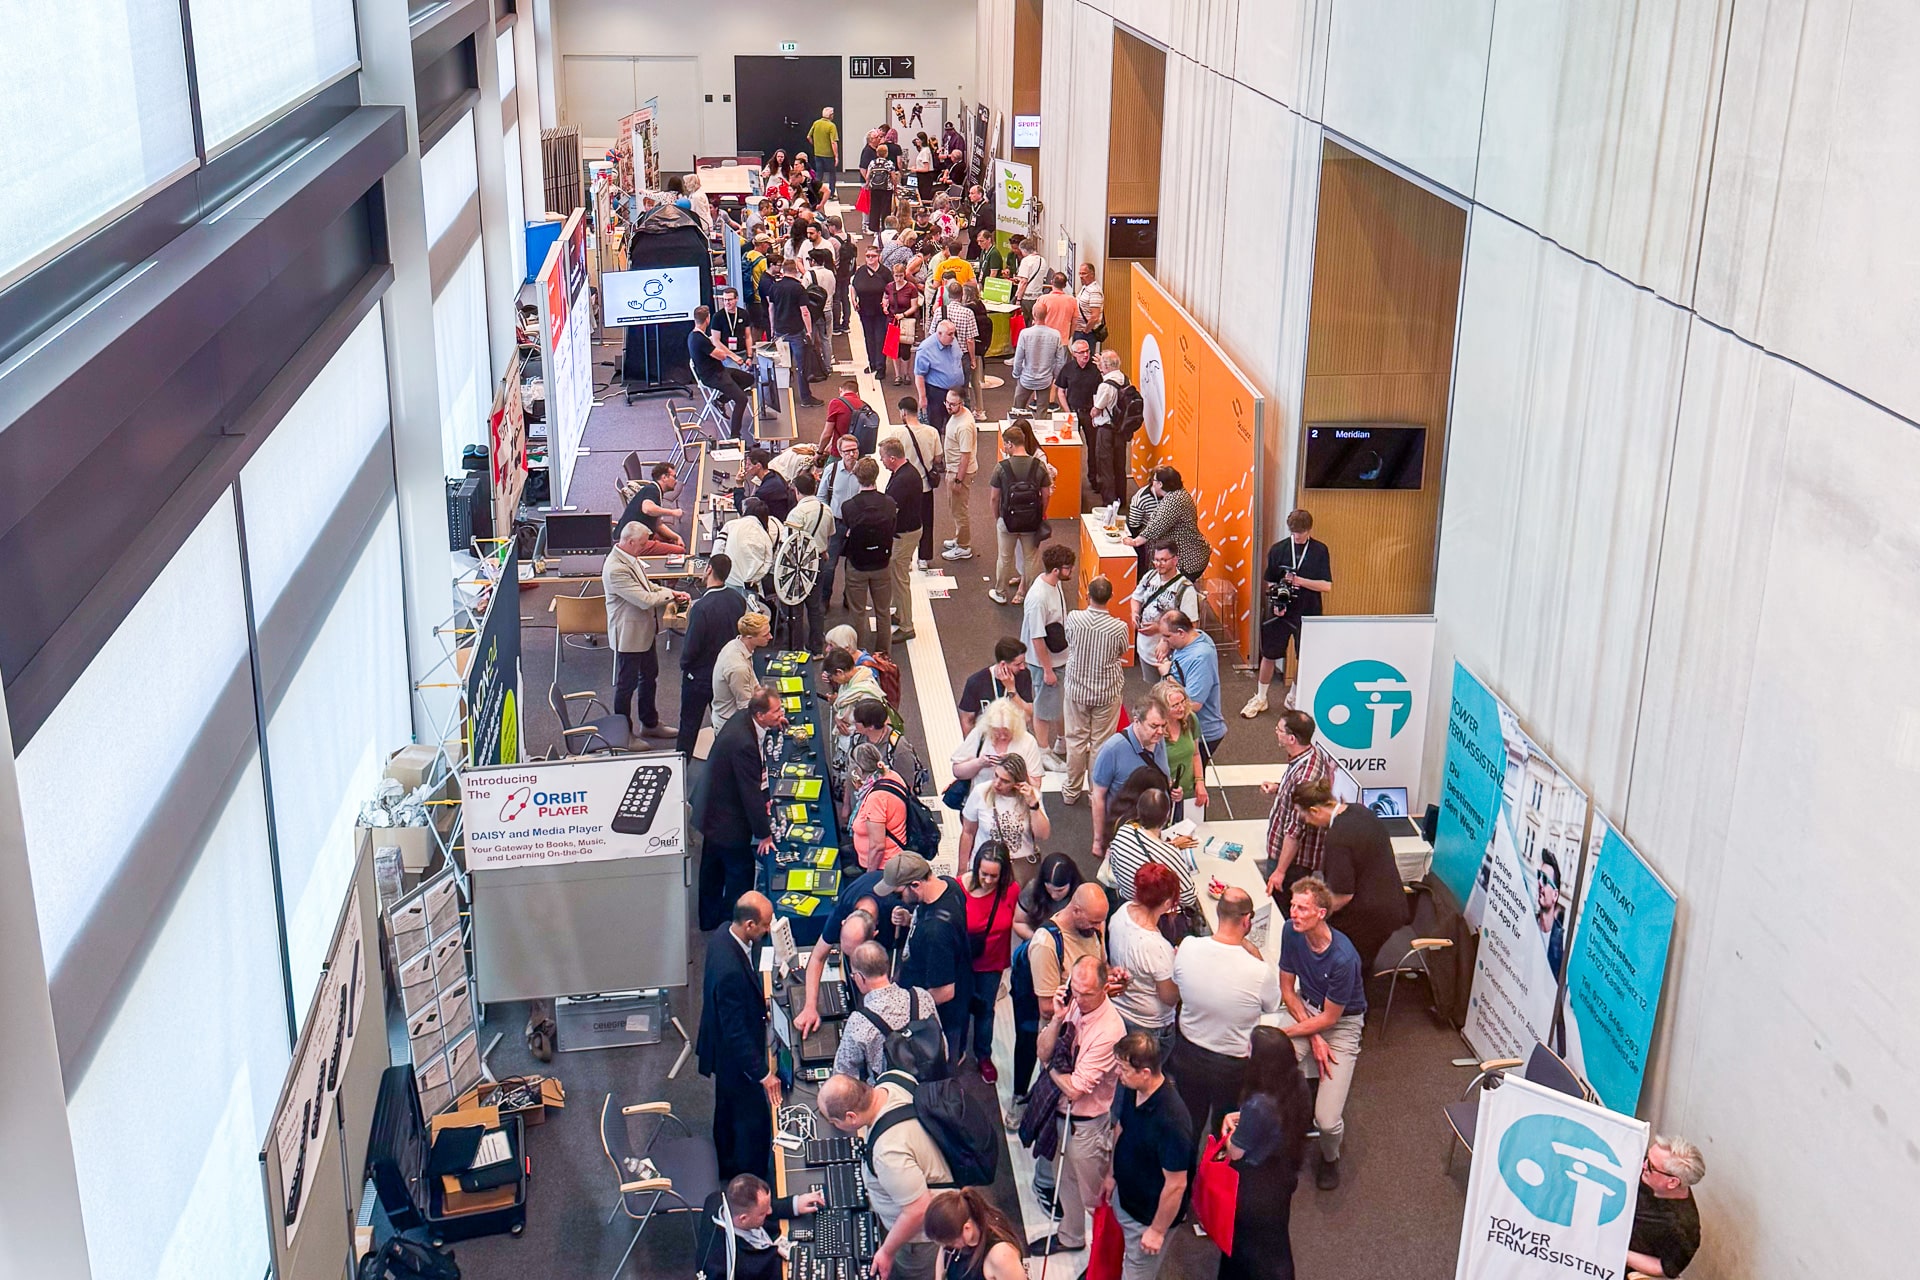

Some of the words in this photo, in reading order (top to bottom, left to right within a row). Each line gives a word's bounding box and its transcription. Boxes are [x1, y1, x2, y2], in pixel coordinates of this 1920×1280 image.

[1311, 430, 1318, 438] 2
[1336, 430, 1370, 438] Meridian
[1452, 696, 1479, 736] TOWER
[1338, 758, 1386, 771] OWER
[1449, 718, 1505, 790] FERNASSISTENZ
[1449, 761, 1460, 778] Du
[467, 774, 538, 787] Introducing
[467, 791, 491, 800] The
[533, 791, 588, 806] ORBIT
[538, 806, 589, 817] PLAYER
[1447, 778, 1485, 829] bestimmst
[471, 831, 507, 841] DAISY
[509, 828, 530, 839] and
[532, 826, 566, 837] Media
[568, 824, 604, 836] Player
[1445, 798, 1458, 819] den
[1459, 813, 1477, 840] Weg.
[472, 845, 493, 854] Your
[494, 842, 534, 854] Gateway
[535, 841, 544, 849] to
[546, 839, 576, 849] Books,
[578, 838, 607, 847] Music,
[487, 854, 504, 862] and
[506, 851, 546, 863] Learning
[547, 847, 593, 858] On-the-Go
[1495, 855, 1512, 880] Deine
[1491, 884, 1519, 922] Assistenz
[1493, 871, 1527, 914] persönliche
[1601, 870, 1636, 917] KONTAKT
[1489, 897, 1498, 913] via
[1498, 909, 1511, 929] App
[1512, 923, 1522, 940] für
[1595, 902, 1619, 936] TOWER
[1592, 917, 1636, 976] Fernassistenz
[1638, 996, 1647, 1012] 12
[1490, 1216, 1550, 1247] TOWER
[1487, 1231, 1615, 1280] FERNASSISTENZ
